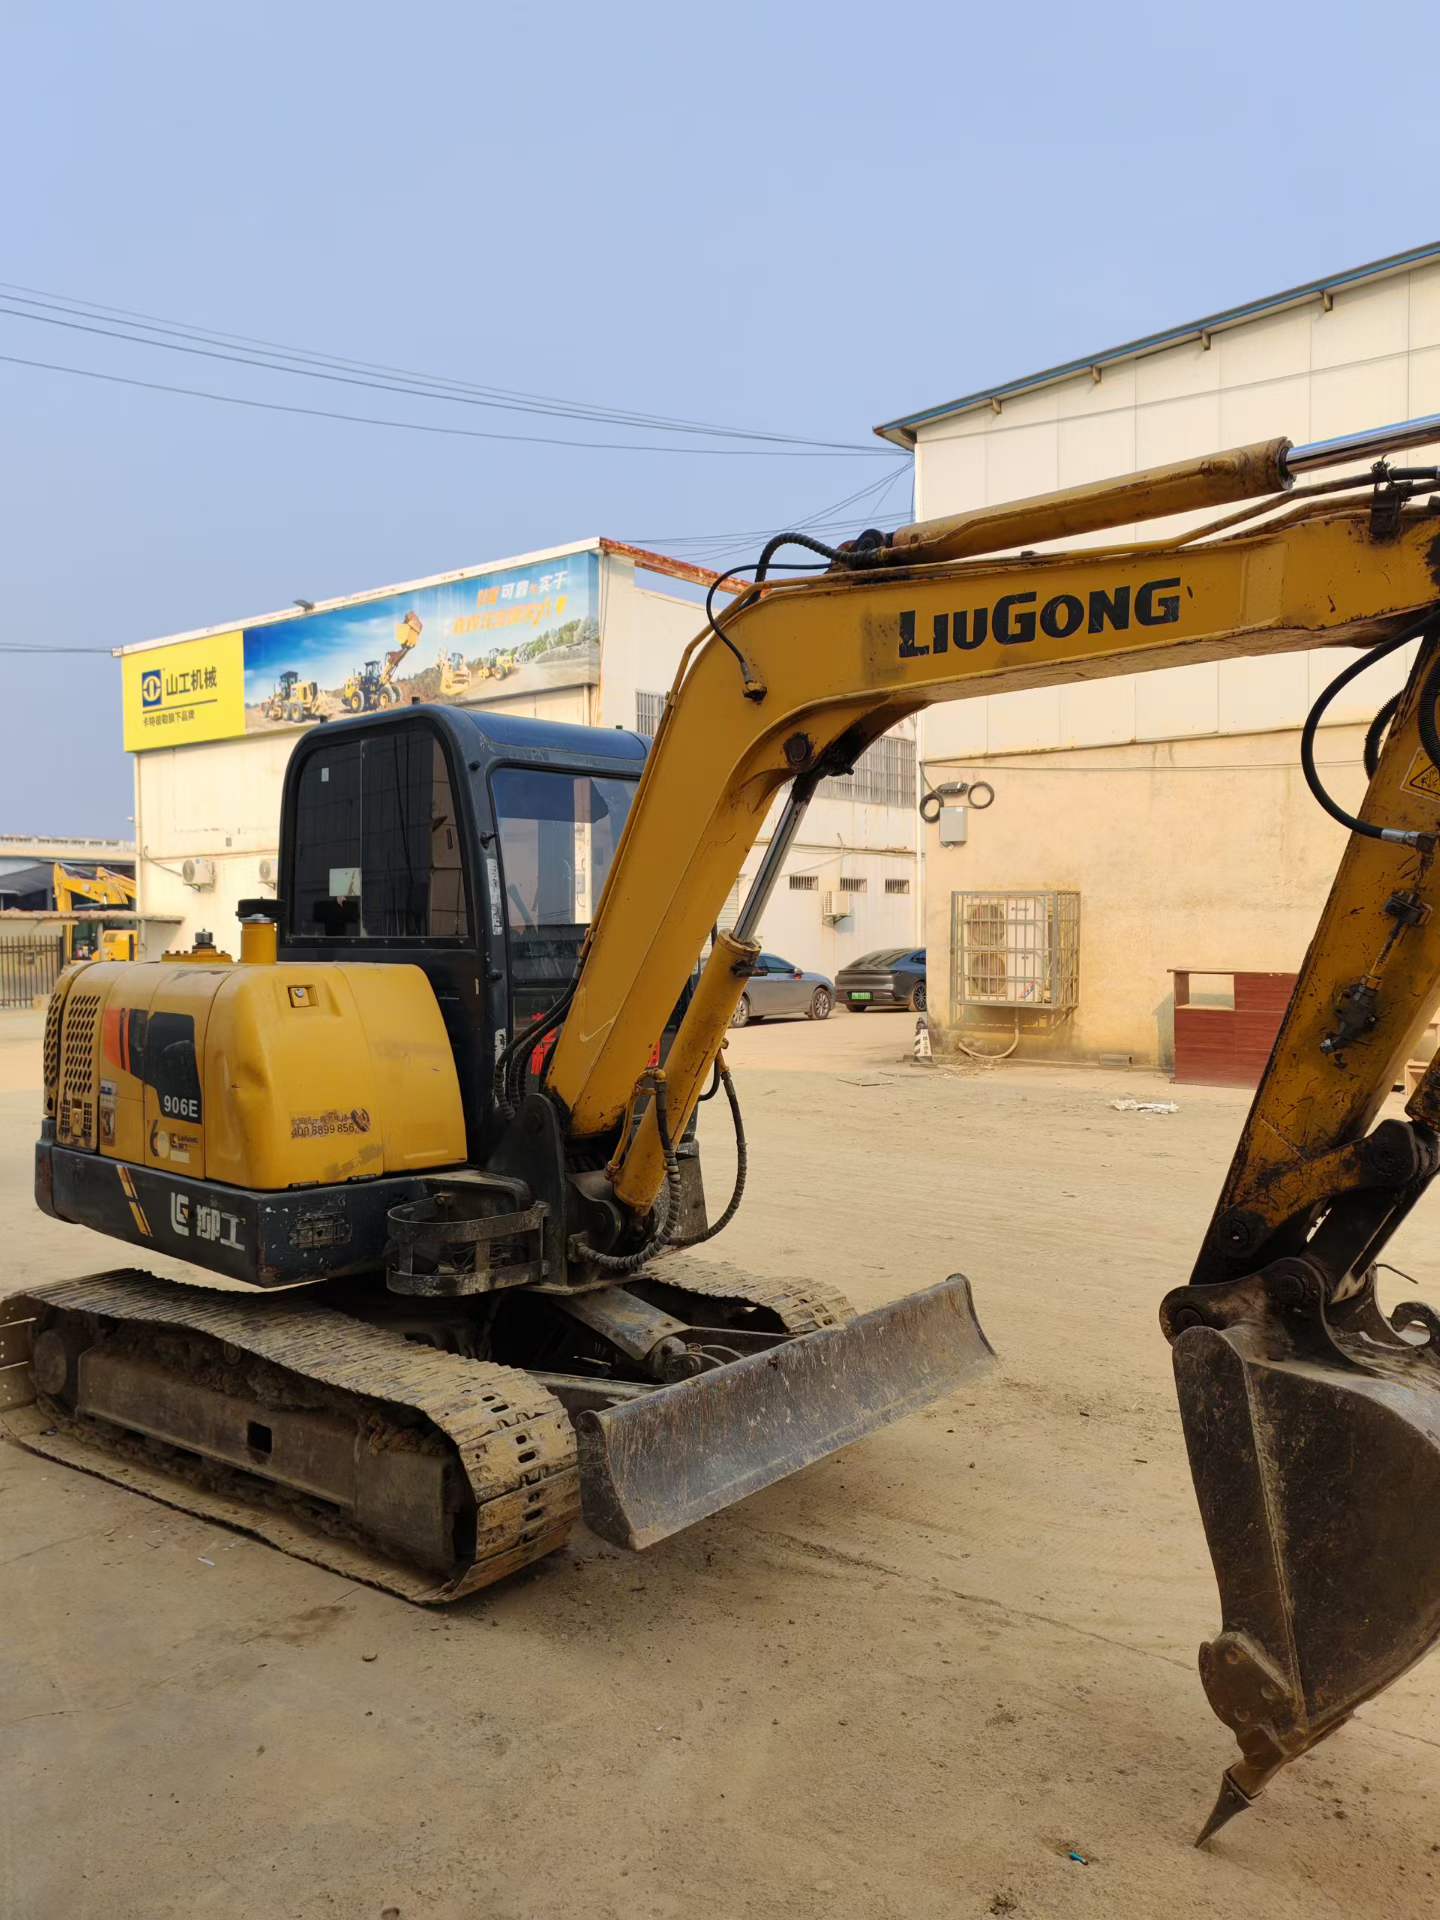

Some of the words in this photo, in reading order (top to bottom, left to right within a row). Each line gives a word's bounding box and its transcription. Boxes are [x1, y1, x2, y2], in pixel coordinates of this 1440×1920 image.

[166, 666, 217, 696] 山工机械
[163, 1095, 198, 1118] 906E
